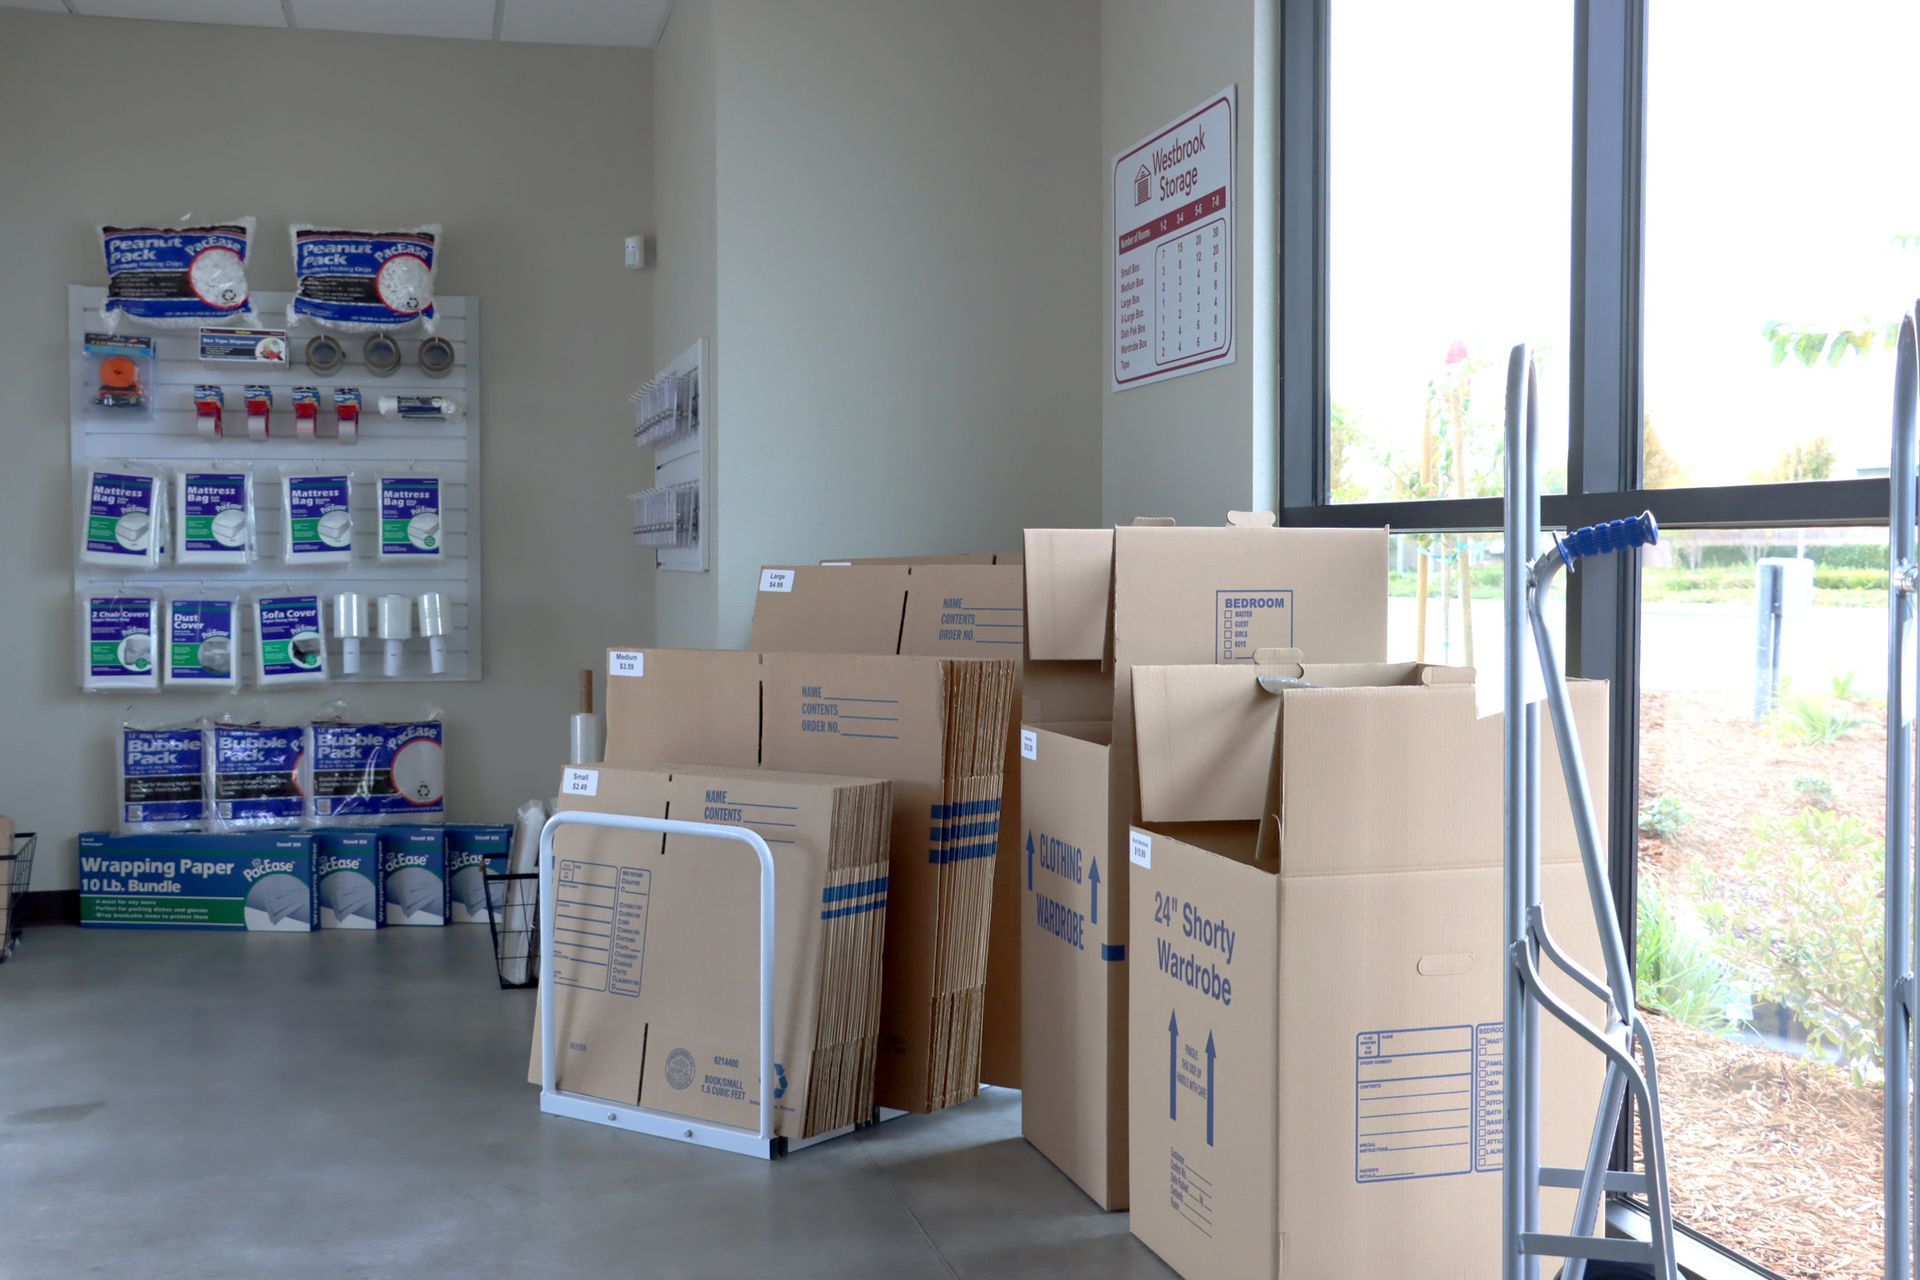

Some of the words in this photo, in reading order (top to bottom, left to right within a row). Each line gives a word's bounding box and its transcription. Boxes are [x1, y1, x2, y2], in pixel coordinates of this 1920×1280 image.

[1152, 123, 1206, 176] Westbrook
[1159, 166, 1198, 202] Storage
[110, 237, 183, 252] Peanut
[184, 236, 242, 256] PacEase
[110, 249, 158, 265] Pack
[302, 244, 373, 257] Peanut
[374, 243, 429, 263] PacEase
[302, 253, 348, 268] Pack
[1132, 263, 1140, 275] Box
[1136, 277, 1144, 289] Box
[1120, 296, 1132, 309] Large
[1132, 294, 1140, 305] Box
[1136, 308, 1144, 319] Box
[1137, 324, 1146, 335] Box
[1138, 339, 1147, 350] Box
[94, 485, 142, 498] Mattress
[187, 486, 236, 495] Mattress
[291, 489, 339, 499] Mattress
[383, 490, 430, 499] Mattress
[93, 493, 116, 505] Bag
[187, 494, 209, 504] Bag
[292, 498, 314, 507] Bag
[383, 498, 404, 508] Bag
[769, 572, 786, 581] Large
[769, 581, 784, 589] $4.99
[943, 598, 963, 609] NAME
[1225, 598, 1285, 609] BEDROOM
[99, 610, 121, 618] Chair
[122, 610, 149, 618] Covers
[174, 613, 199, 622] Dust
[262, 610, 285, 619] Sofa
[286, 608, 317, 618] Cover
[941, 613, 976, 625] CONTENTS
[174, 621, 205, 630] Cover
[938, 629, 961, 640] ORDER
[962, 630, 975, 641] NO.
[616, 653, 638, 661] Medium
[801, 686, 823, 699] NAME
[801, 702, 839, 716] CONTENTS
[801, 719, 826, 733] ORDER
[827, 720, 840, 734] NO.
[219, 737, 288, 749] Bubble
[317, 733, 384, 746] Bubble
[386, 726, 438, 751] PacEase
[128, 739, 201, 752] Bubble
[128, 752, 178, 765] Pack
[219, 749, 265, 762] Pack
[317, 746, 363, 759] Pack
[573, 772, 590, 781] Small
[572, 782, 588, 791] $2.49
[705, 789, 728, 804] NAME
[704, 806, 743, 822] CONTENTS
[319, 855, 360, 875] acEase
[385, 852, 427, 872] acEase
[451, 852, 492, 871] acEas
[1039, 832, 1083, 885] CLOTHING
[81, 857, 176, 878] Wrapping
[180, 858, 235, 879] Paper
[81, 878, 100, 891] 10
[102, 878, 125, 892] Lb.
[128, 879, 182, 893] Bundle
[1036, 892, 1085, 951] WARDROBE
[1154, 890, 1178, 927] 24"
[1182, 901, 1236, 965] Shorty
[1157, 937, 1232, 1006] Wardrobe
[1479, 1026, 1504, 1034] BEDROO
[704, 1074, 744, 1090] BOOK/SMALL
[701, 1084, 711, 1095] 1.5
[711, 1086, 730, 1098] CUBIC
[730, 1089, 747, 1100] FEET
